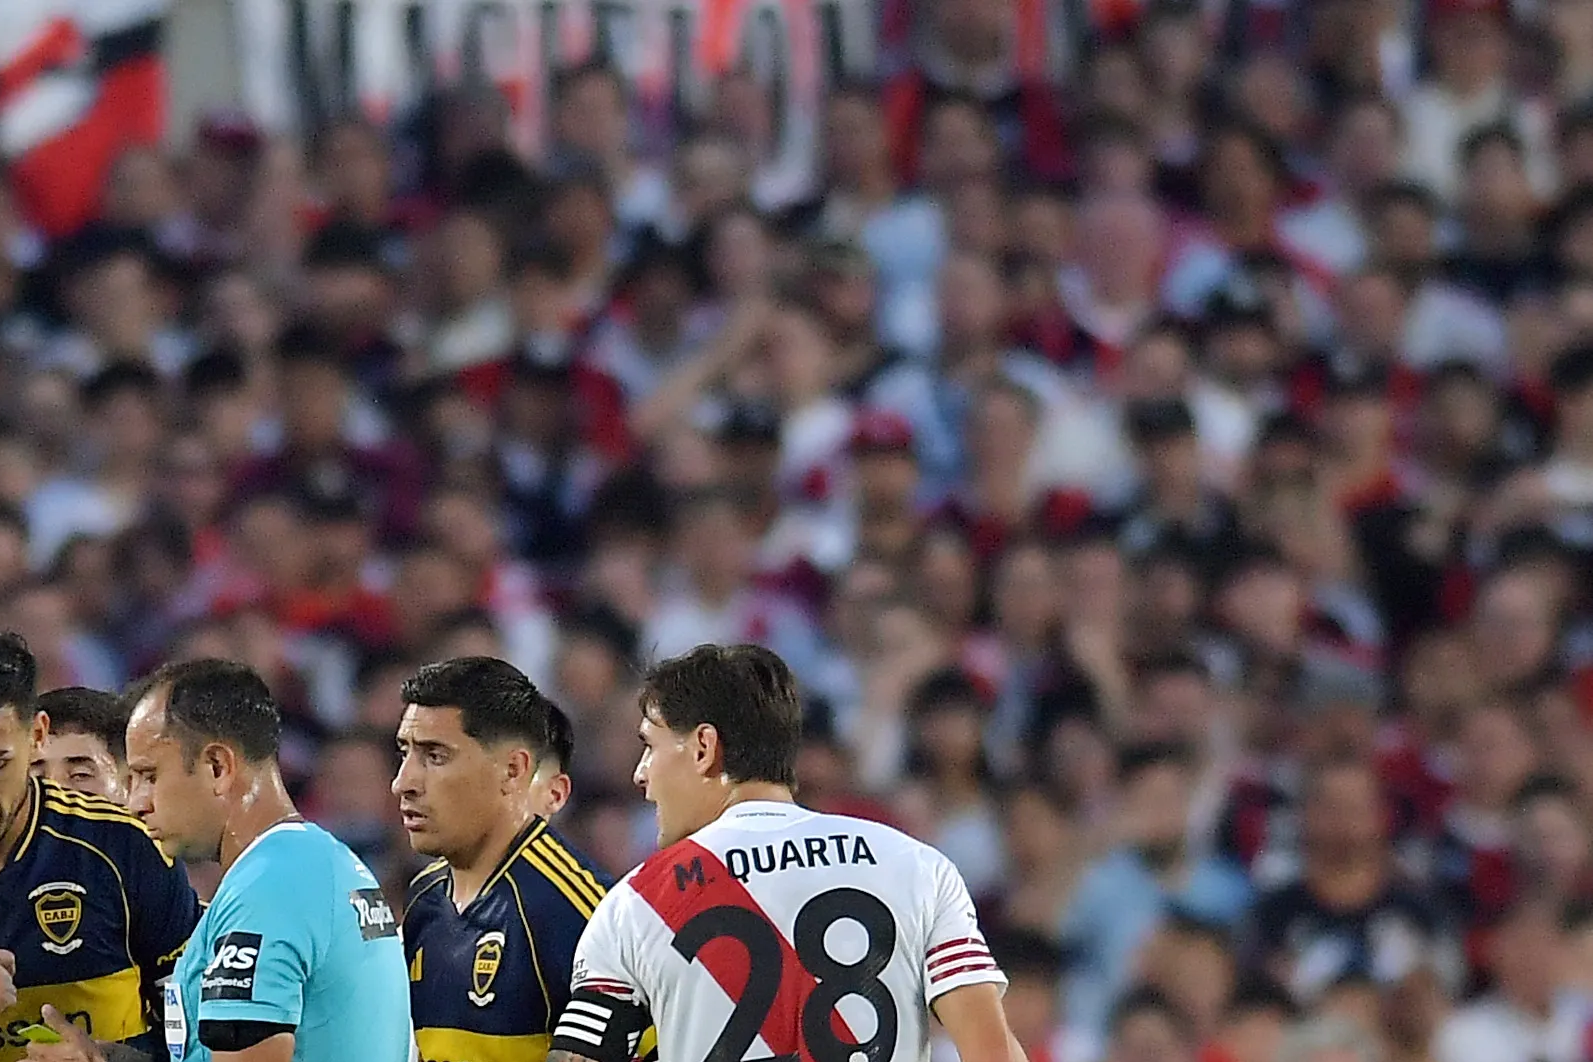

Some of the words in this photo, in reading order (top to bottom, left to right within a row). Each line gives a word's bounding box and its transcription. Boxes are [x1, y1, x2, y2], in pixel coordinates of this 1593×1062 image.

[673, 856, 716, 891] M.
[725, 835, 877, 883] QUARTA
[44, 910, 74, 921] CABJ
[204, 944, 259, 976] RS
